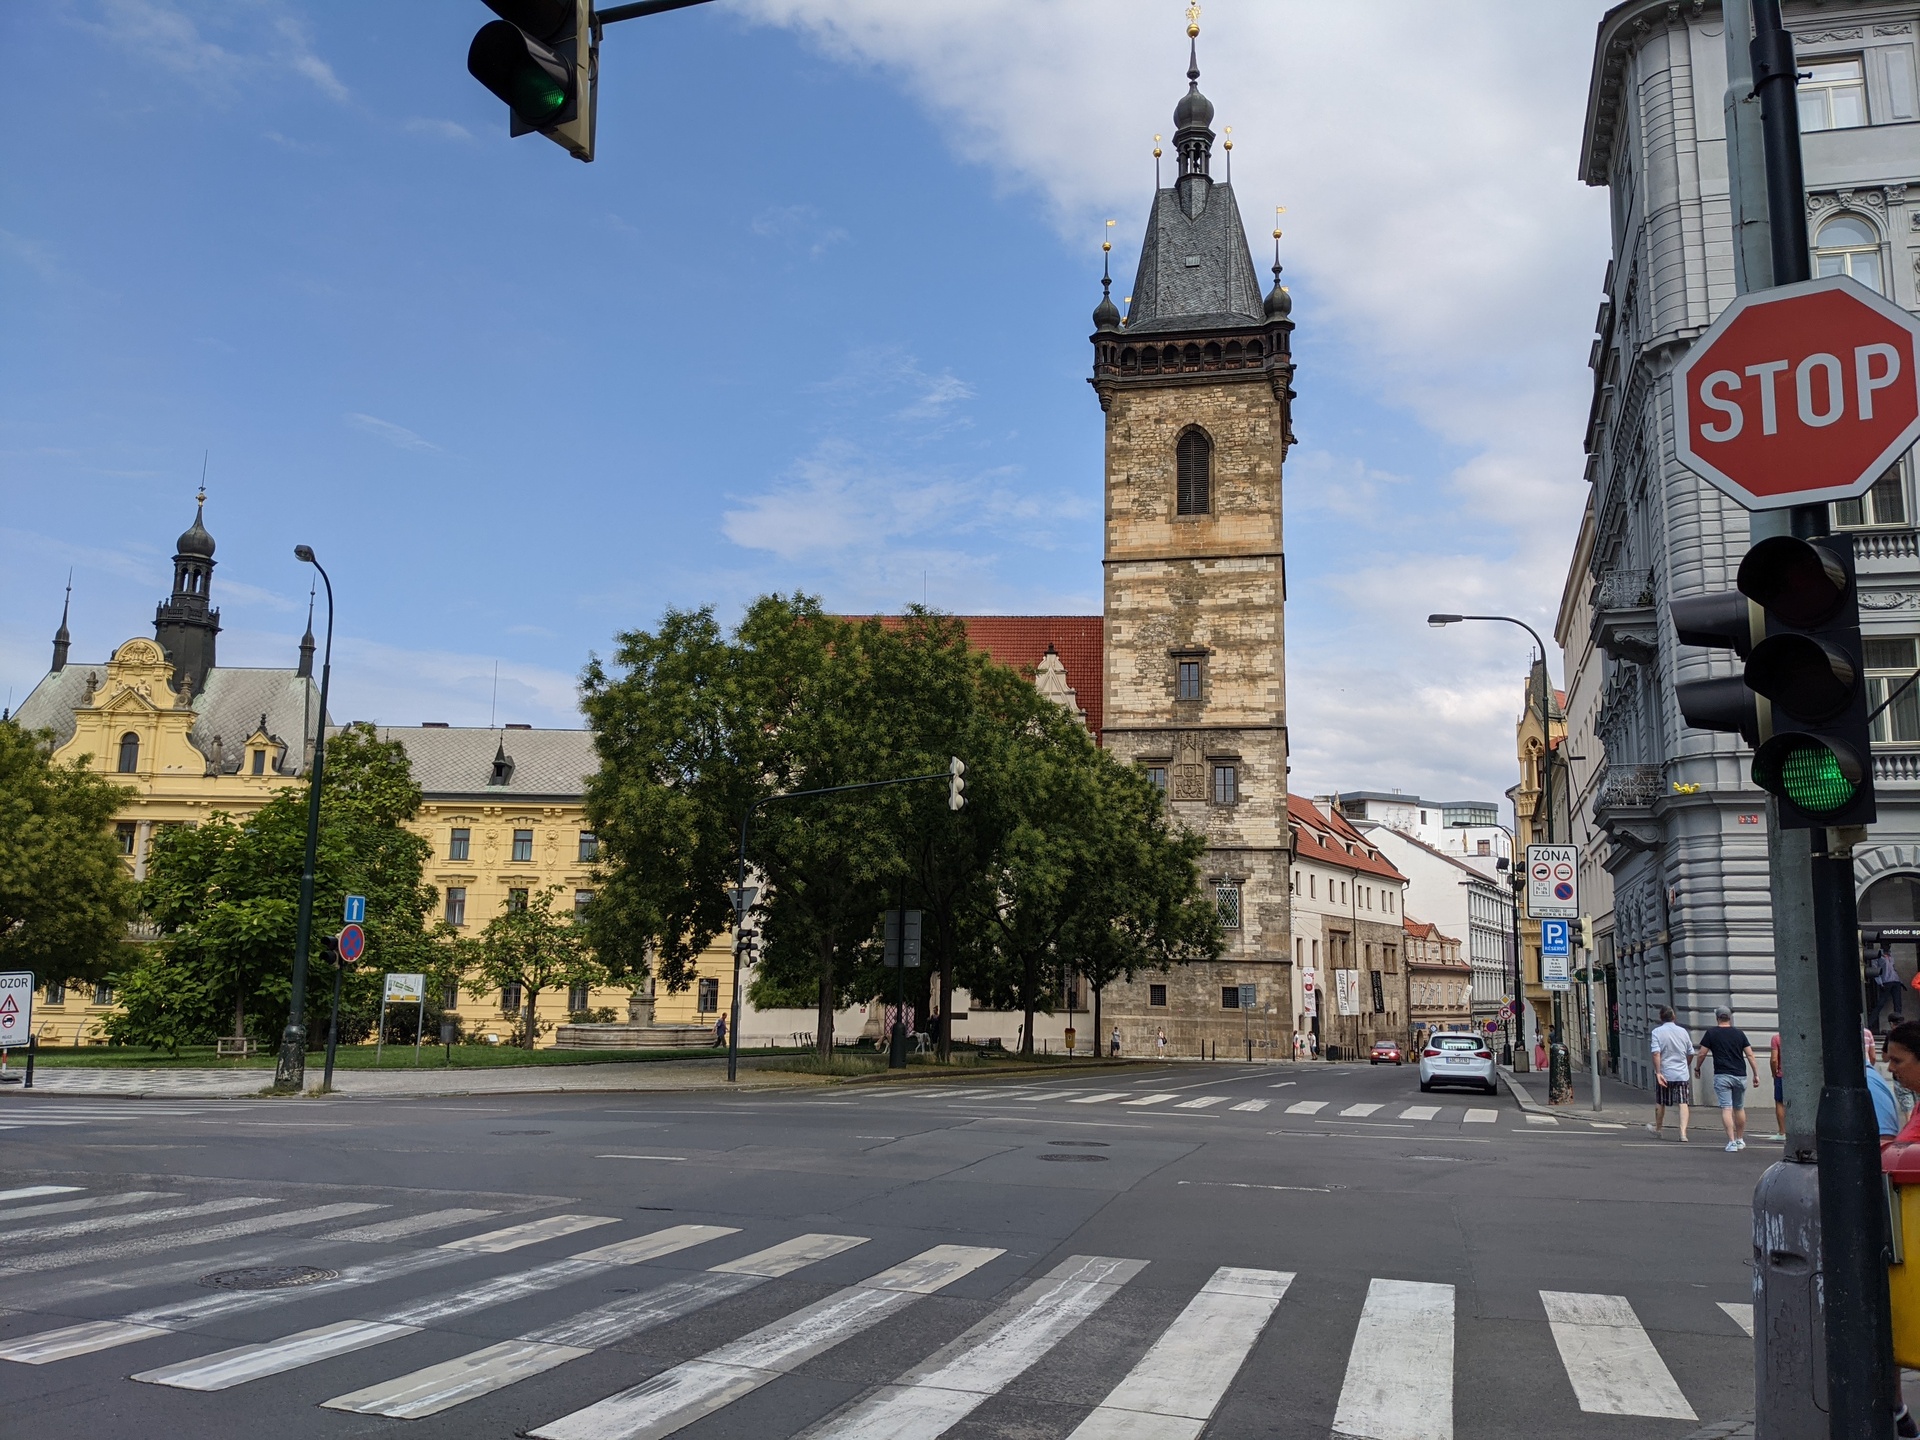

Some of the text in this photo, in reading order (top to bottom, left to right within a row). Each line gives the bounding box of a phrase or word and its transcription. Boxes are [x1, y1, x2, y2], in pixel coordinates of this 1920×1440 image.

[1699, 342, 1901, 443] STOP
[1533, 848, 1571, 861] ZÓNA
[1547, 924, 1562, 944] P
[0, 977, 29, 989] OZOR
